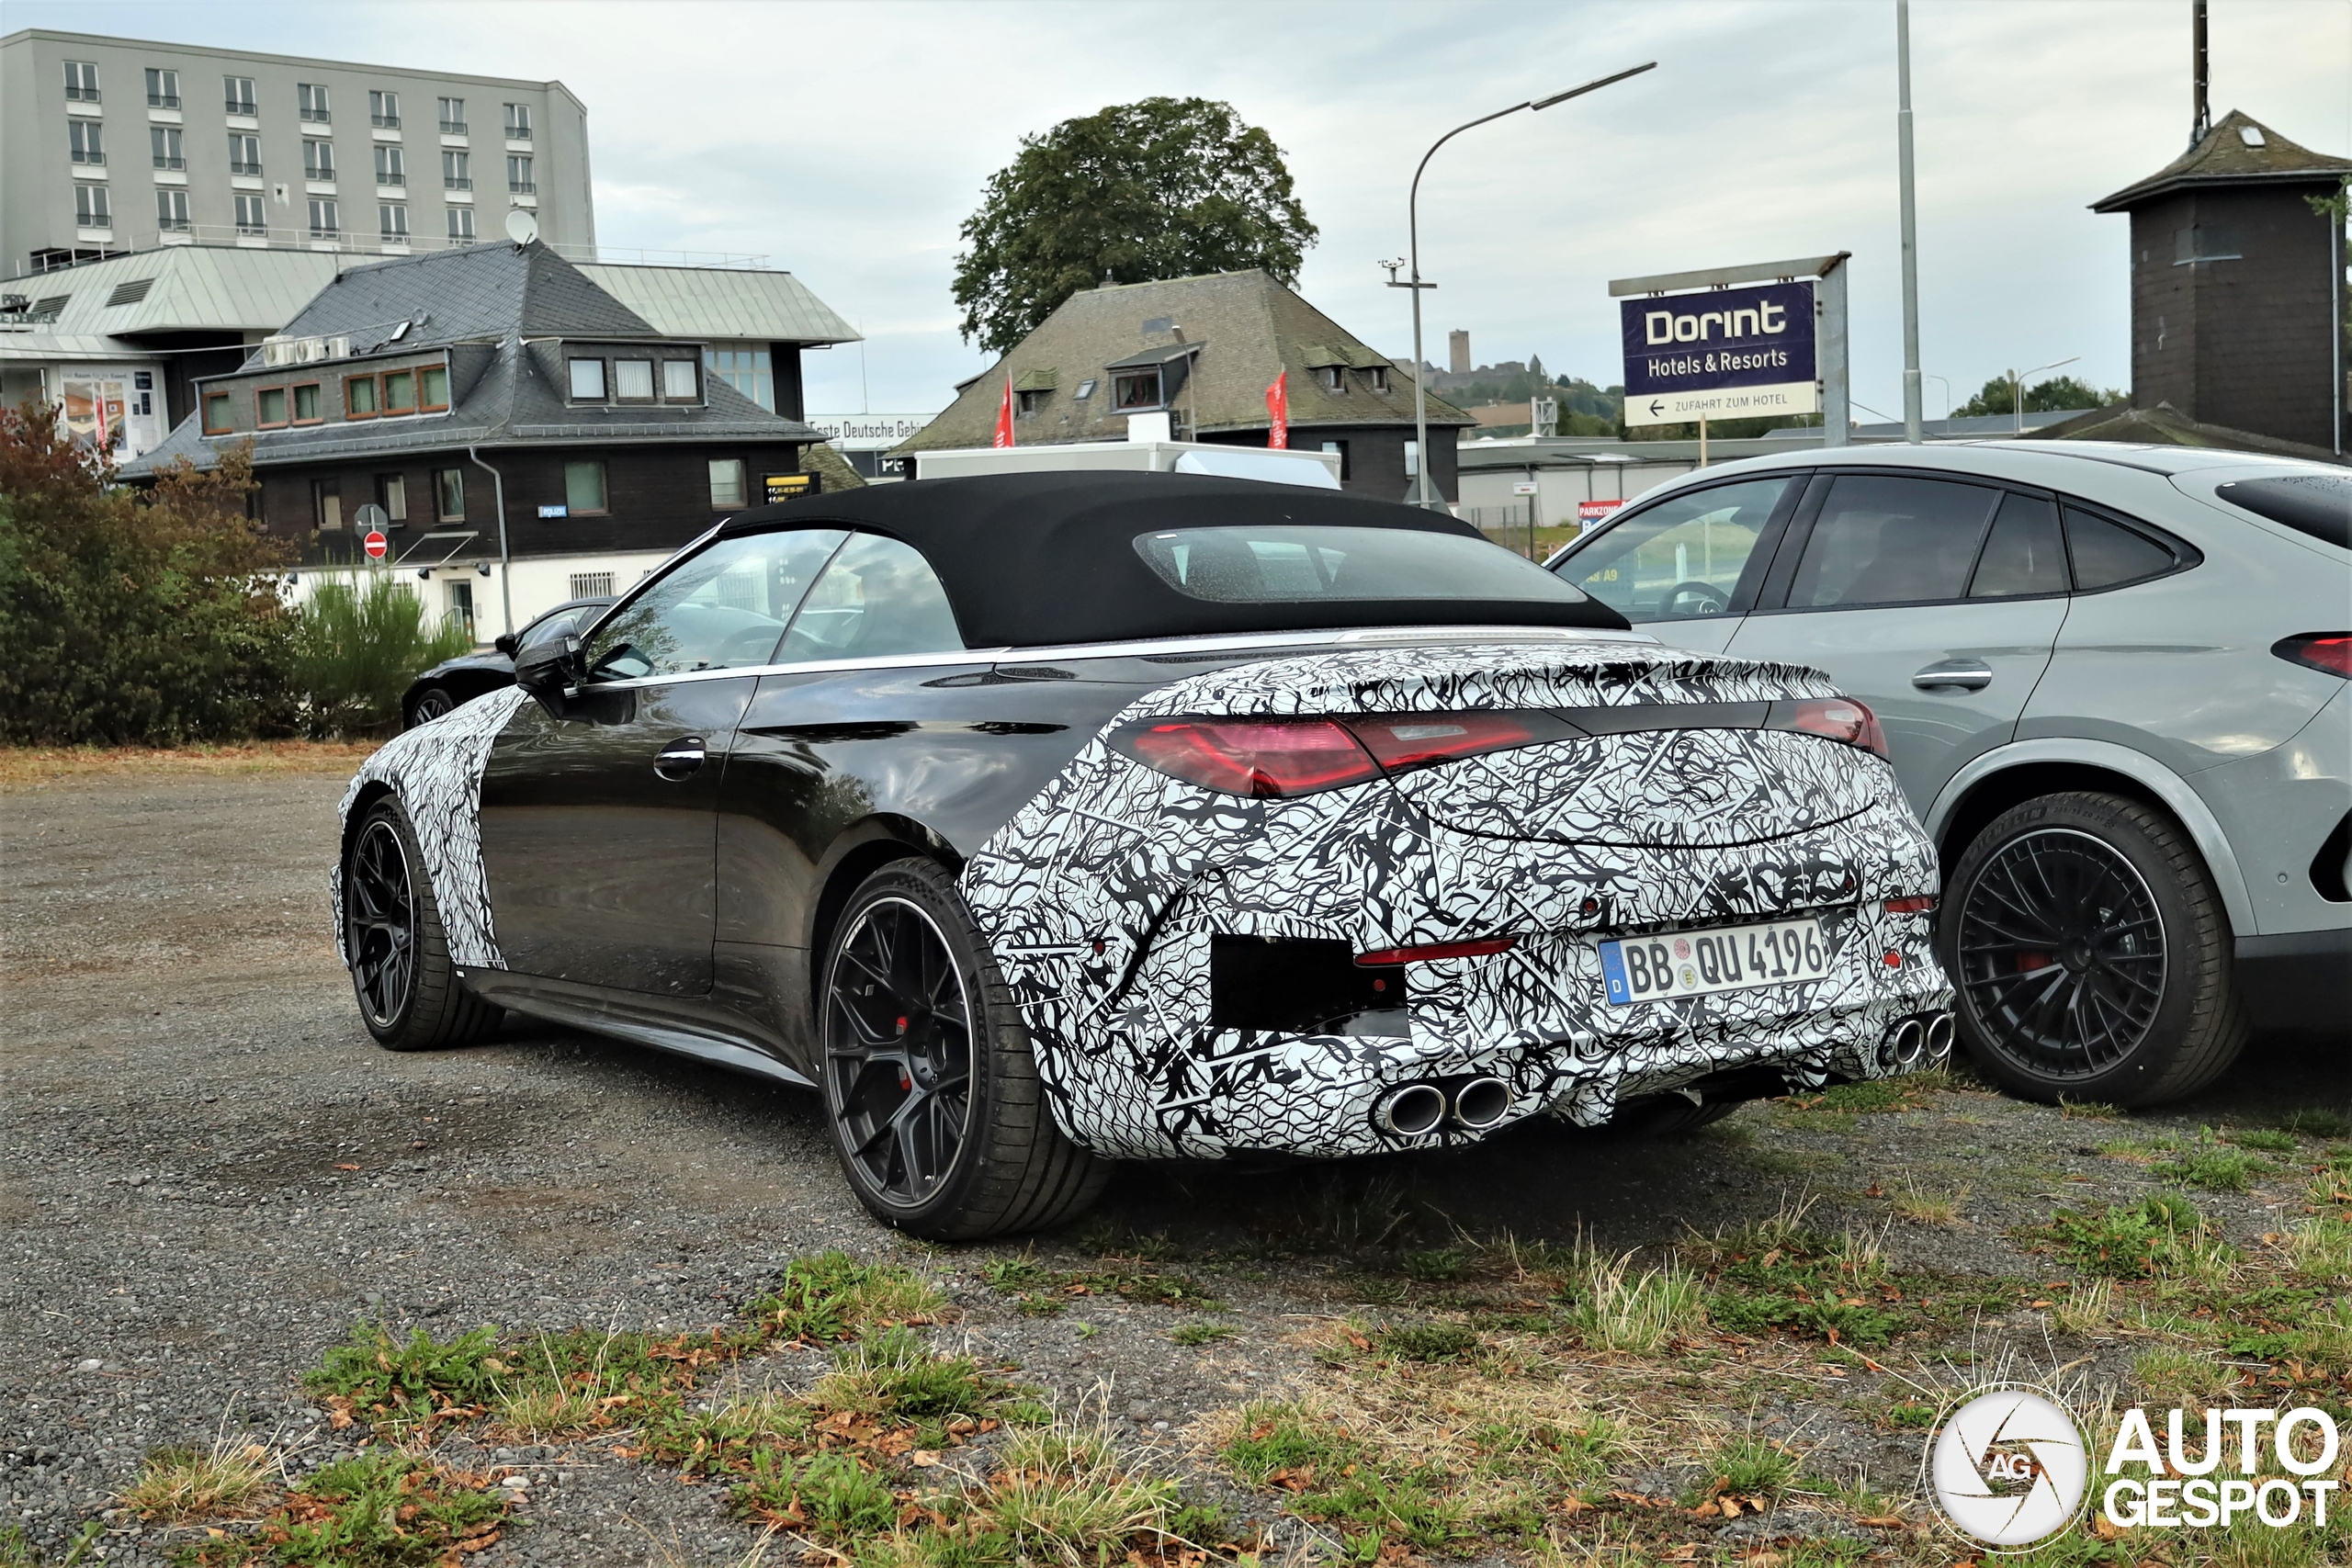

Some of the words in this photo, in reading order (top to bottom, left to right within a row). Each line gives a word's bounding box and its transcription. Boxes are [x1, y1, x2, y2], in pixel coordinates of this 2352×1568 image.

[1645, 300, 1786, 345] Dorint
[1648, 355, 1701, 378] Hotels
[1704, 354, 1717, 372] &
[1720, 349, 1787, 371] Resorts
[1675, 399, 1723, 412] ZUFAHRT
[1725, 397, 1749, 408] ZUM
[1753, 394, 1788, 406] HOTEL
[843, 421, 894, 438] Deutsche
[897, 421, 926, 437] Gebi
[1603, 569, 1618, 581] A9
[1626, 943, 1674, 993] BB
[1696, 935, 1743, 985] QU
[1749, 927, 1823, 978] 4196
[1611, 979, 1622, 993] D
[975, 1002, 988, 1099] MICHELIN
